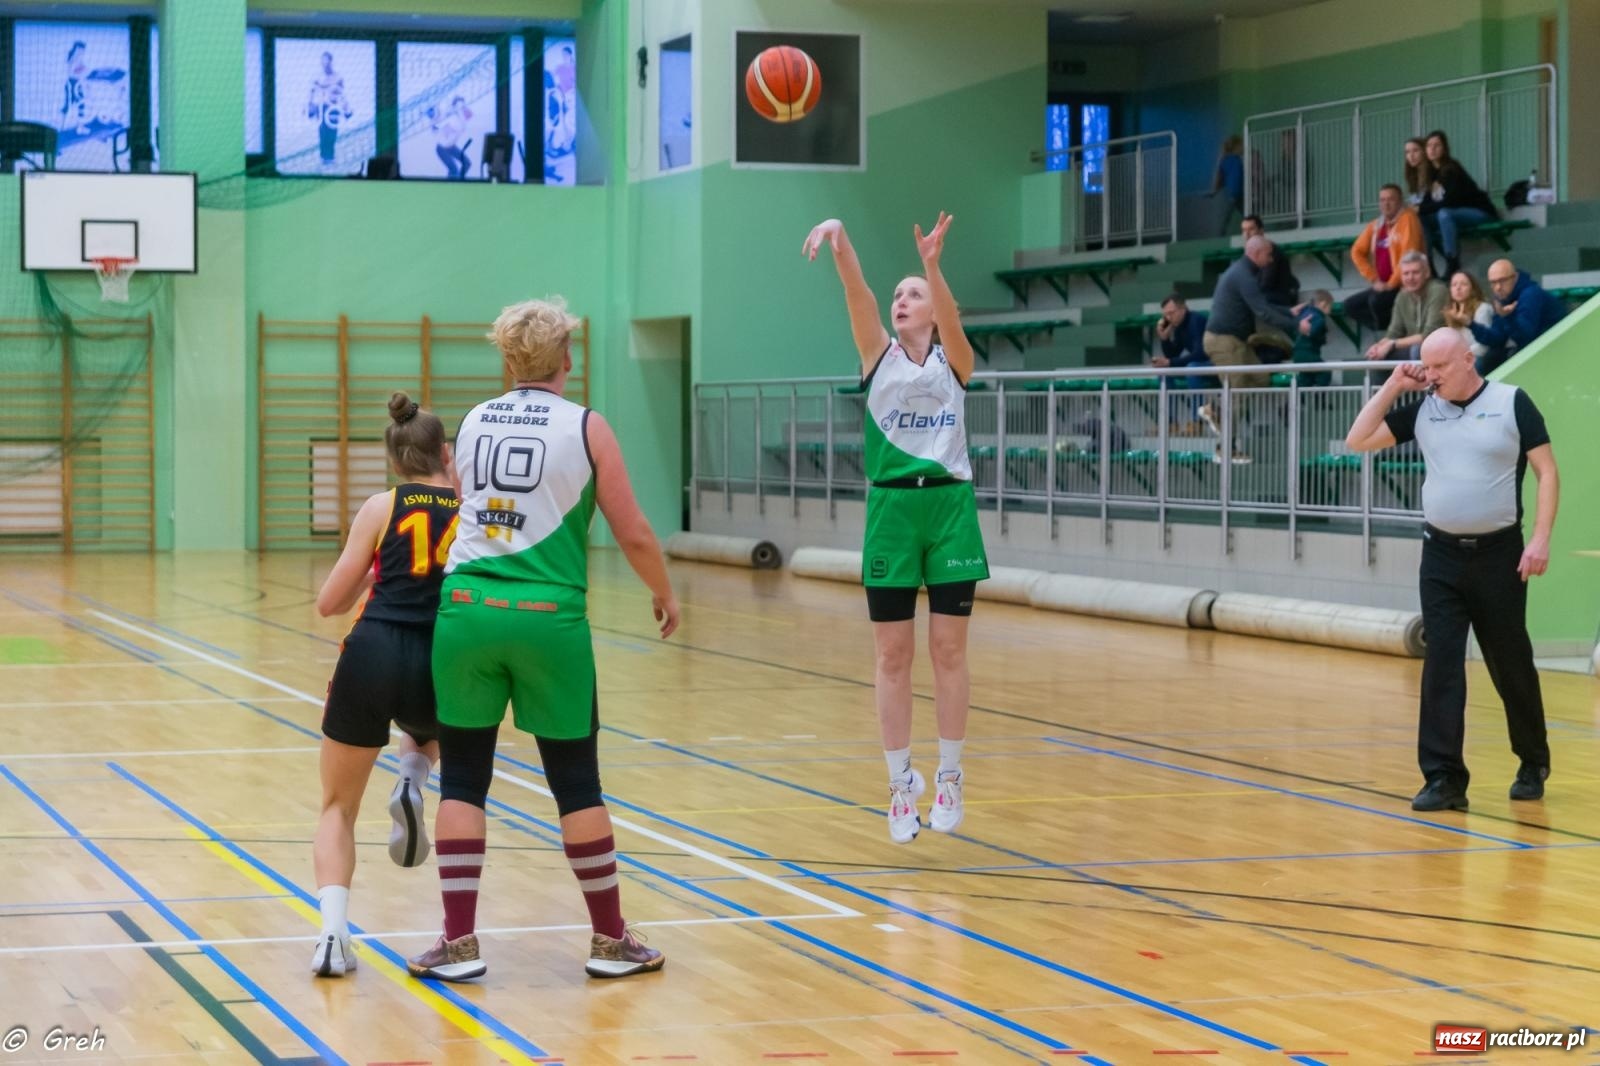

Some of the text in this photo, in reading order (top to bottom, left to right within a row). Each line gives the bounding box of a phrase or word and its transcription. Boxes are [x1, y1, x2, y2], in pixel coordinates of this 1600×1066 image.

[523, 404, 551, 413] AZS
[480, 413, 549, 426] RACIBÓRZ
[898, 409, 956, 428] Clavis
[473, 434, 546, 493] 10
[403, 494, 433, 506] ISWJ
[479, 511, 523, 529] SEGET
